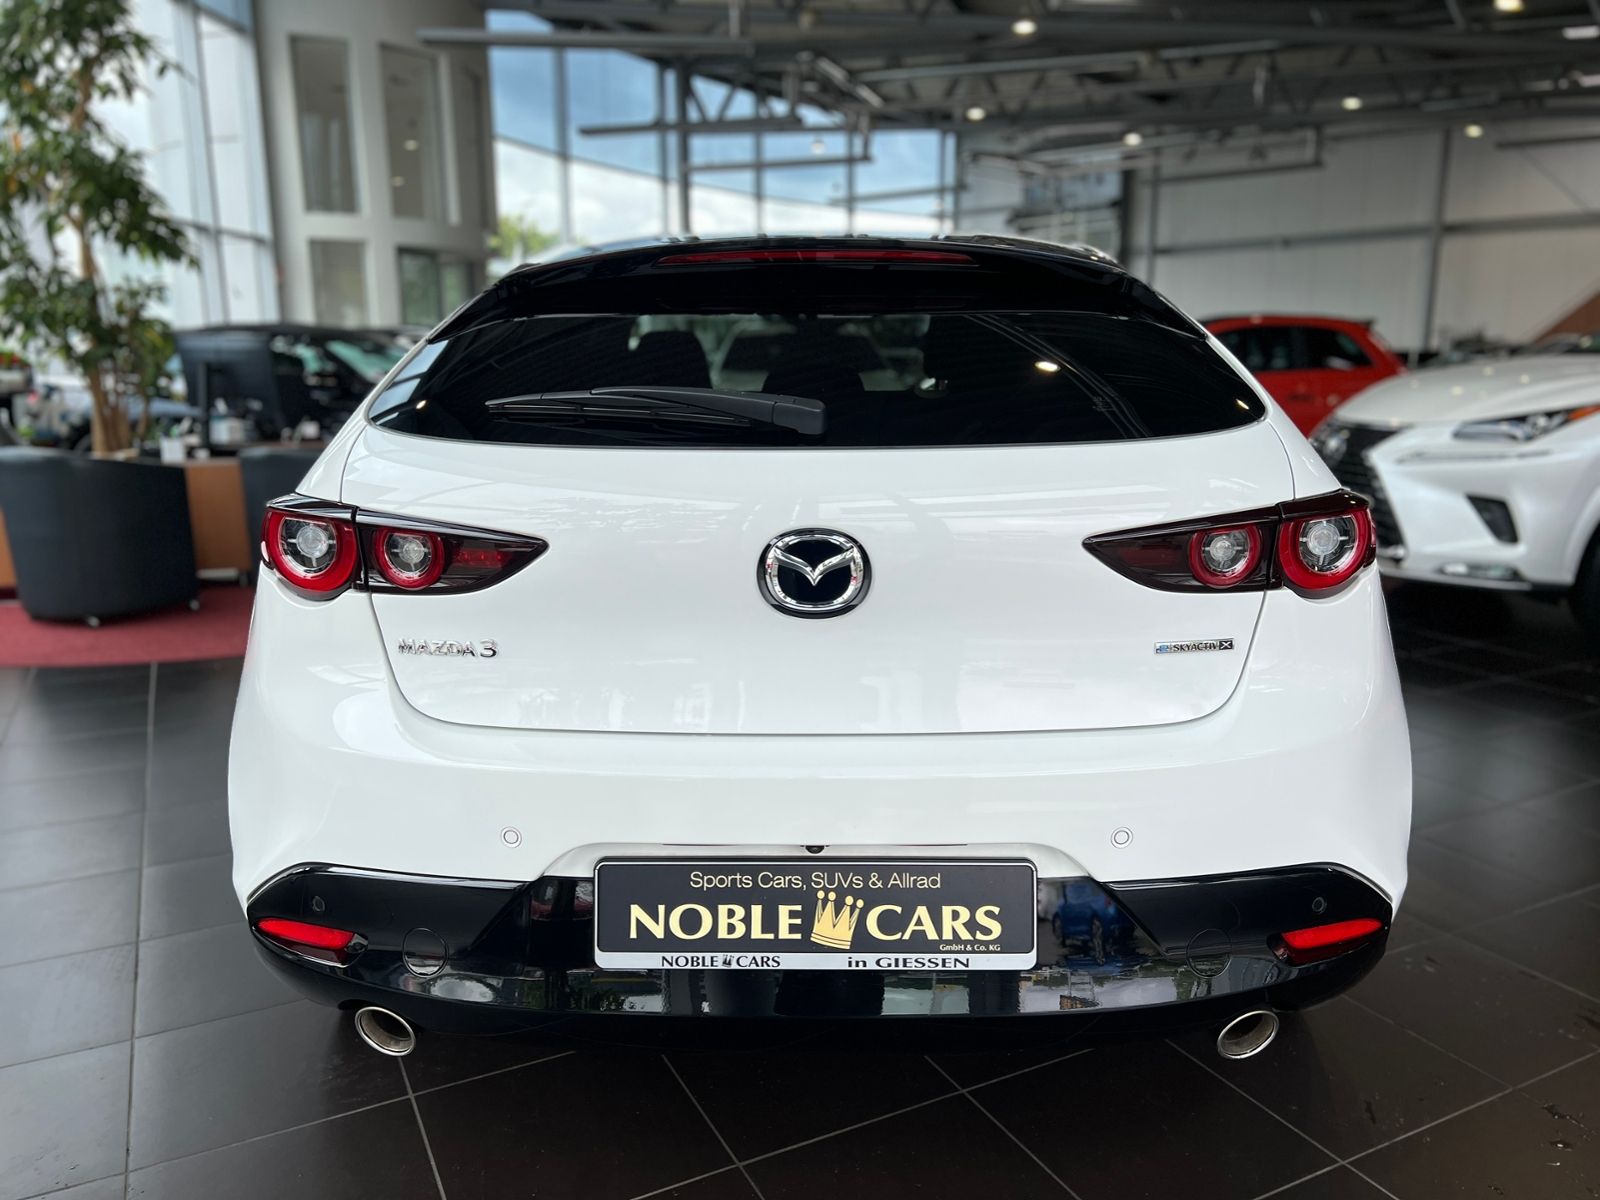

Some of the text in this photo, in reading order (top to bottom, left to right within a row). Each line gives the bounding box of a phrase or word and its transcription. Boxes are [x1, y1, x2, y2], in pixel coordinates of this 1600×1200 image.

[398, 639, 498, 658] MAZDA 3
[690, 871, 941, 891] Sports Cars, SUVs & Allrad
[629, 904, 1001, 941] NOBLE CARS
[661, 956, 780, 969] NOBLE CARS
[848, 957, 970, 969] in GIESSEN
